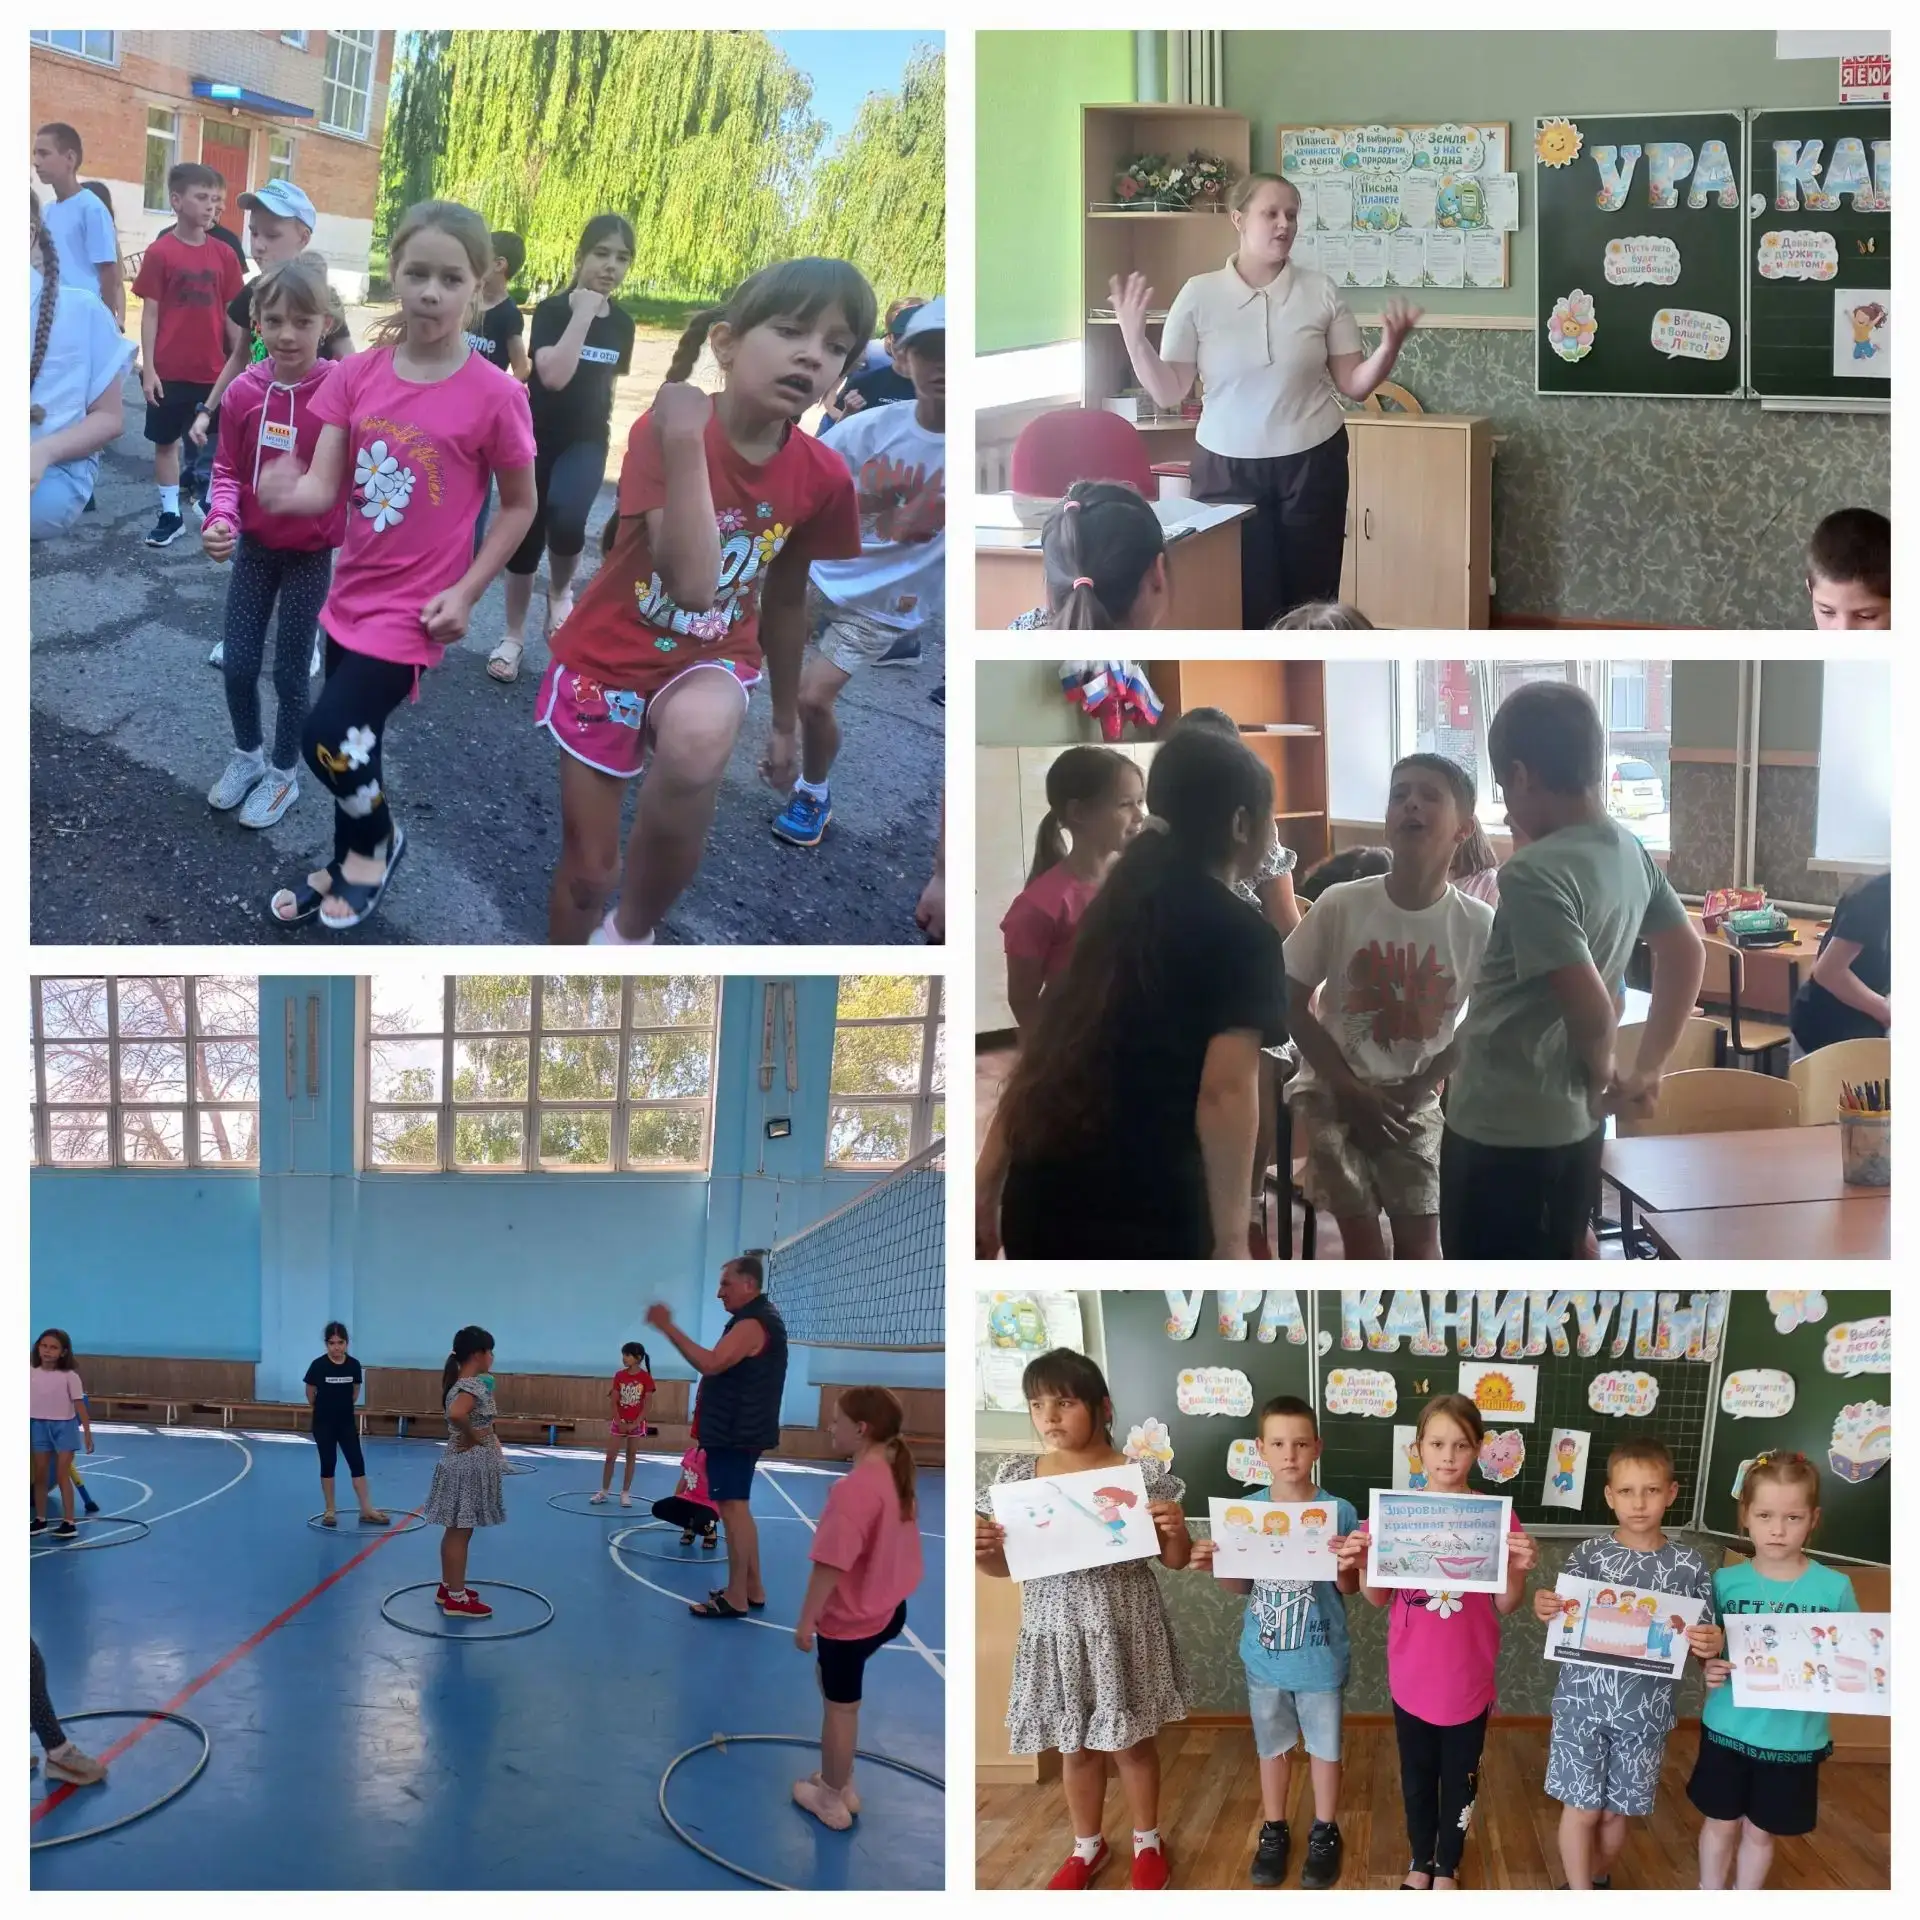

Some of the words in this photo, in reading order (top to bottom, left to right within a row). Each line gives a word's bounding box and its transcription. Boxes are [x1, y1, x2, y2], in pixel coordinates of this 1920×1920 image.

[1295, 136, 1336, 146] Планета
[1356, 133, 1364, 143] Я
[1366, 135, 1402, 144] выбираю
[1428, 132, 1467, 144] Земля
[1294, 147, 1340, 156] начинается
[1356, 145, 1376, 153] быть
[1377, 146, 1405, 155] другом
[1433, 146, 1440, 155] у
[1443, 146, 1462, 154] нас
[1362, 156, 1398, 165] природы
[1433, 156, 1463, 165] одна
[1361, 183, 1398, 193] Письма
[1360, 195, 1399, 204] Планете
[1624, 244, 1649, 254] Пусть
[1651, 244, 1671, 253] лето
[1671, 338, 1709, 354] Лето!
[1384, 1503, 1447, 1517] Здоровые
[1453, 1503, 1484, 1517] зубы
[1384, 1521, 1444, 1531] красивая
[1448, 1519, 1496, 1531] улыбка
[1707, 1730, 1746, 1753] SUMMER
[1746, 1747, 1757, 1758] IS
[1757, 1751, 1813, 1763] AWESOME
